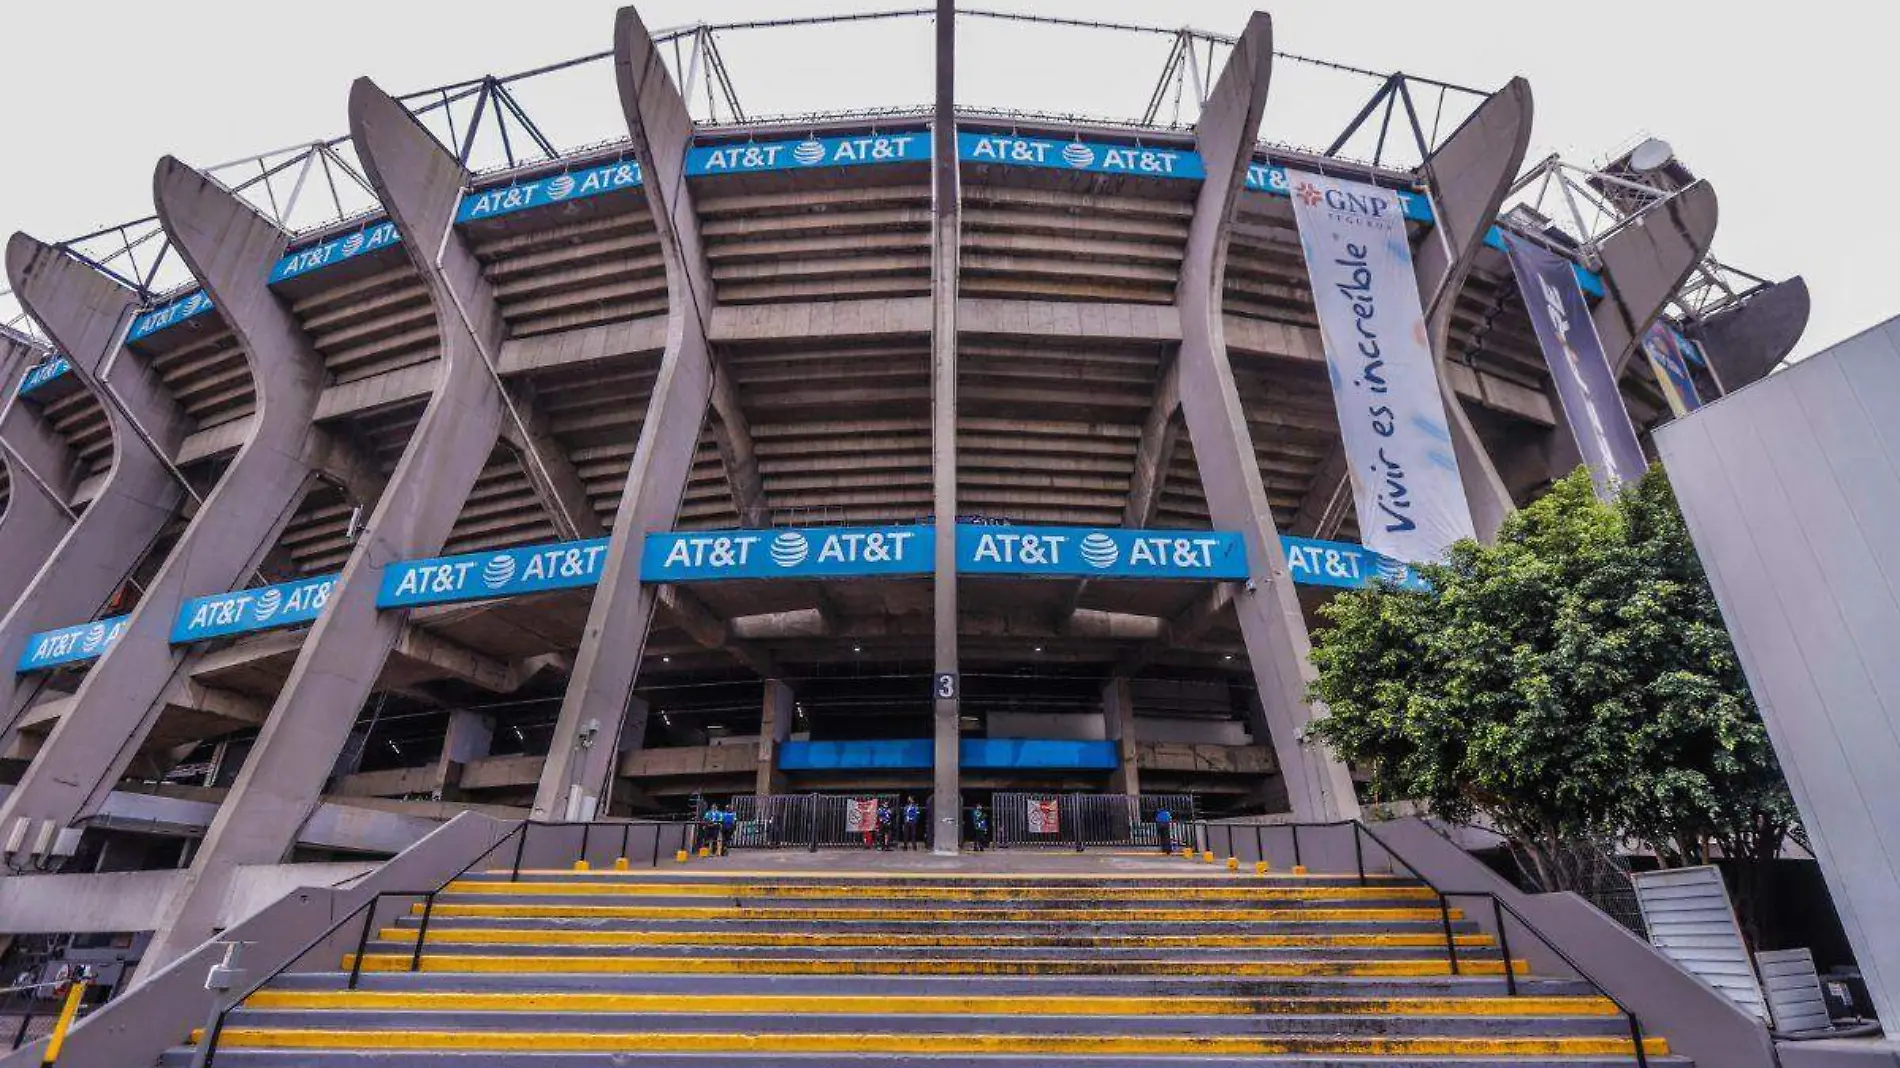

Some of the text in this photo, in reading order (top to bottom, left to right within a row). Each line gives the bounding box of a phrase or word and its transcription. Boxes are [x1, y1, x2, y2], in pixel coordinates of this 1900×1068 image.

[705, 137, 913, 170] AT&T AT&T
[973, 137, 1178, 173] AT&T AT&T
[470, 184, 540, 217] AT&T
[1325, 188, 1388, 218] GNP
[283, 243, 338, 275] AT&T
[1335, 242, 1417, 533] Vivir es increíble
[663, 531, 914, 568] AT&T AT&T
[973, 533, 1218, 568] AT&T AT&T
[1288, 545, 1362, 579] AT&T
[395, 545, 605, 597] AT&T AT&T
[188, 580, 336, 630] AT&T AT&
[32, 631, 84, 662] AT&T
[938, 675, 954, 697] 3
